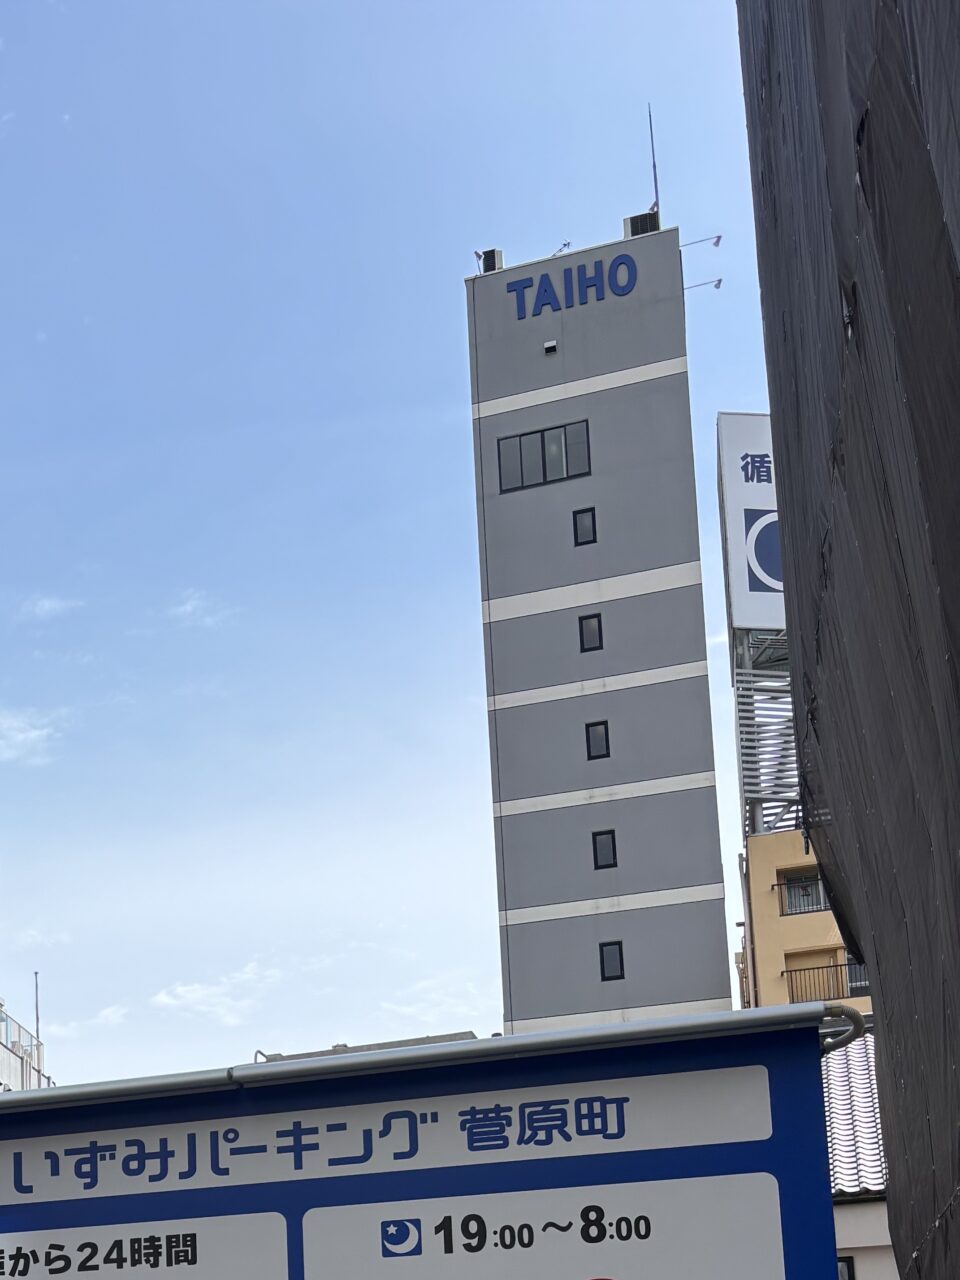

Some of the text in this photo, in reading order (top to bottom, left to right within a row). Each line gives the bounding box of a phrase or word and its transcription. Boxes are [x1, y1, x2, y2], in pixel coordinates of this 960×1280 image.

[506, 253, 637, 320] TAIHO
[740, 453, 772, 484] 循
[13, 1096, 630, 1195] いずみパーキング 菅原町
